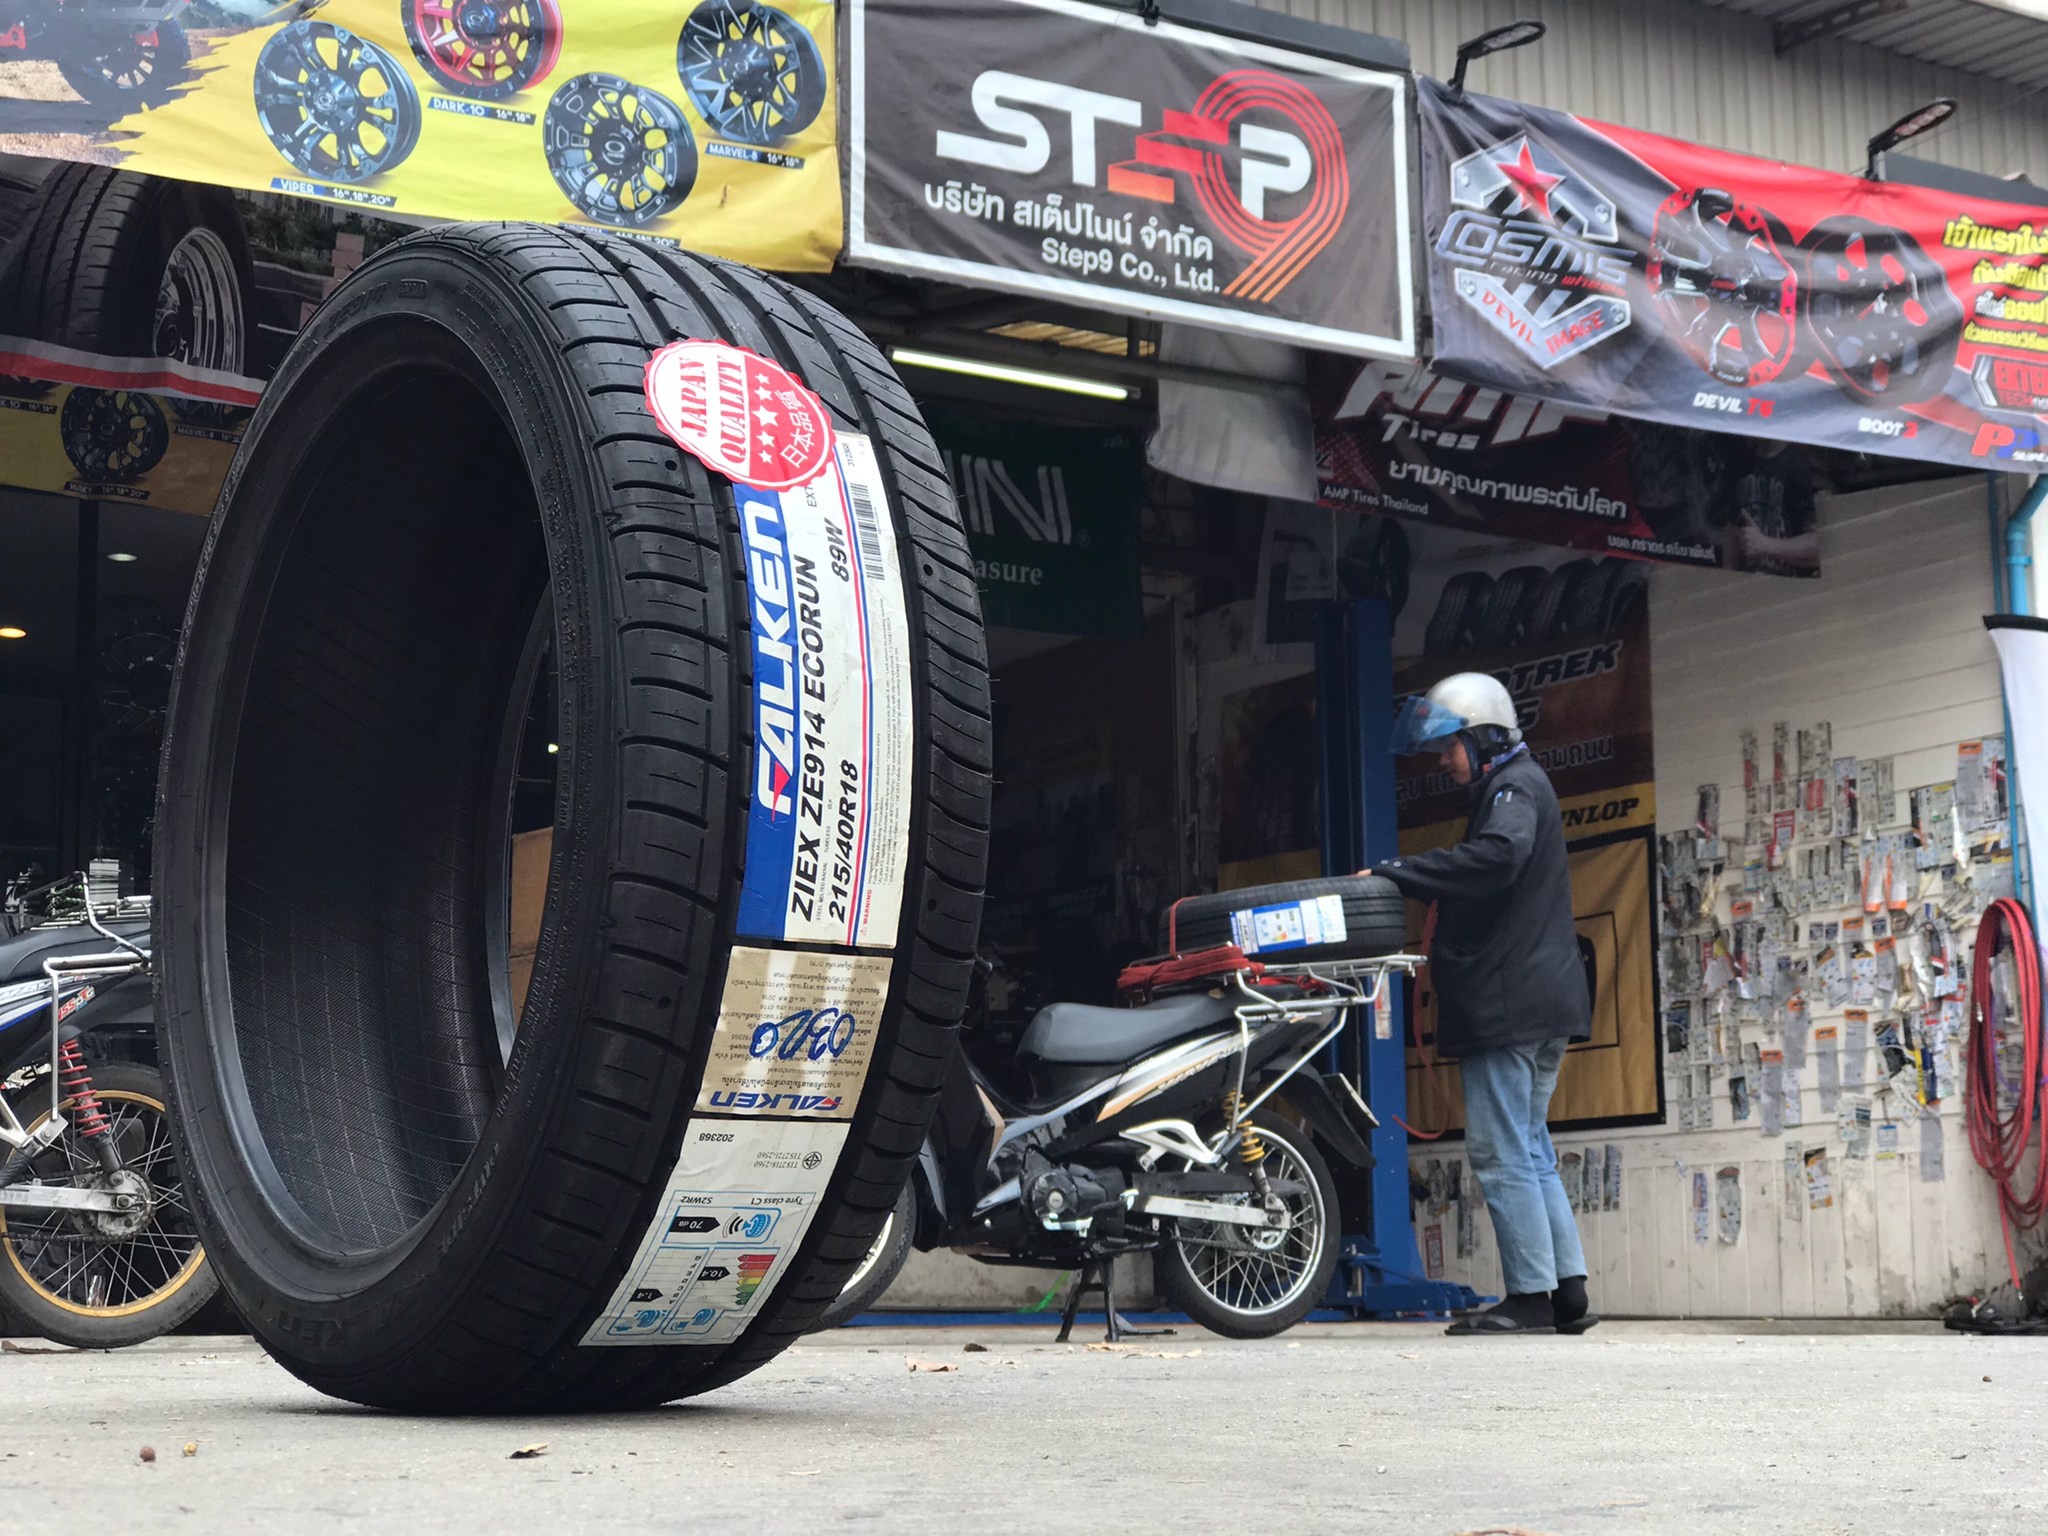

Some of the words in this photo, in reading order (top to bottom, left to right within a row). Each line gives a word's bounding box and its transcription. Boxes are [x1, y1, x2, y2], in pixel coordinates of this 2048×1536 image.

[433, 98, 485, 117] DARK-10
[708, 143, 759, 161] MARVEL-8
[280, 177, 315, 195] VIPER
[923, 180, 1004, 221] บริษัท
[1012, 194, 1133, 247] สเต็ปไนน์
[1139, 217, 1214, 262] จำกัด
[1041, 238, 1114, 275] Step9
[1119, 252, 1167, 289] Co.,
[1174, 266, 1221, 295] Ltd.
[1434, 209, 1638, 288] COSMIS
[1481, 288, 1537, 348] DEVIL
[1545, 307, 1607, 356] IMAGE
[679, 355, 708, 438] JAPAN
[716, 354, 747, 464] QUALITY
[1691, 391, 1743, 414] DEVIL
[1379, 411, 1481, 452] Tires
[1321, 484, 1350, 501] AMP
[1352, 488, 1381, 508] Tires
[1382, 493, 1430, 518] Thailand
[1387, 458, 1629, 521] ยางคุณภาพระดับโลก
[823, 516, 850, 583] 89W
[793, 553, 827, 703] ECORUN
[743, 499, 795, 818] FALKEN
[800, 709, 826, 827] ZE914
[828, 758, 859, 924] 215/40R18
[791, 830, 821, 923] ZIEX
[862, 888, 873, 925] WARNING
[709, 1090, 844, 1111] FALKEN
[698, 1132, 735, 1143] 202368
[681, 1195, 713, 1205] S2WR2
[750, 1196, 762, 1205] C1
[762, 1196, 782, 1205] class
[783, 1196, 804, 1206] Tyre
[690, 1219, 704, 1230] 70
